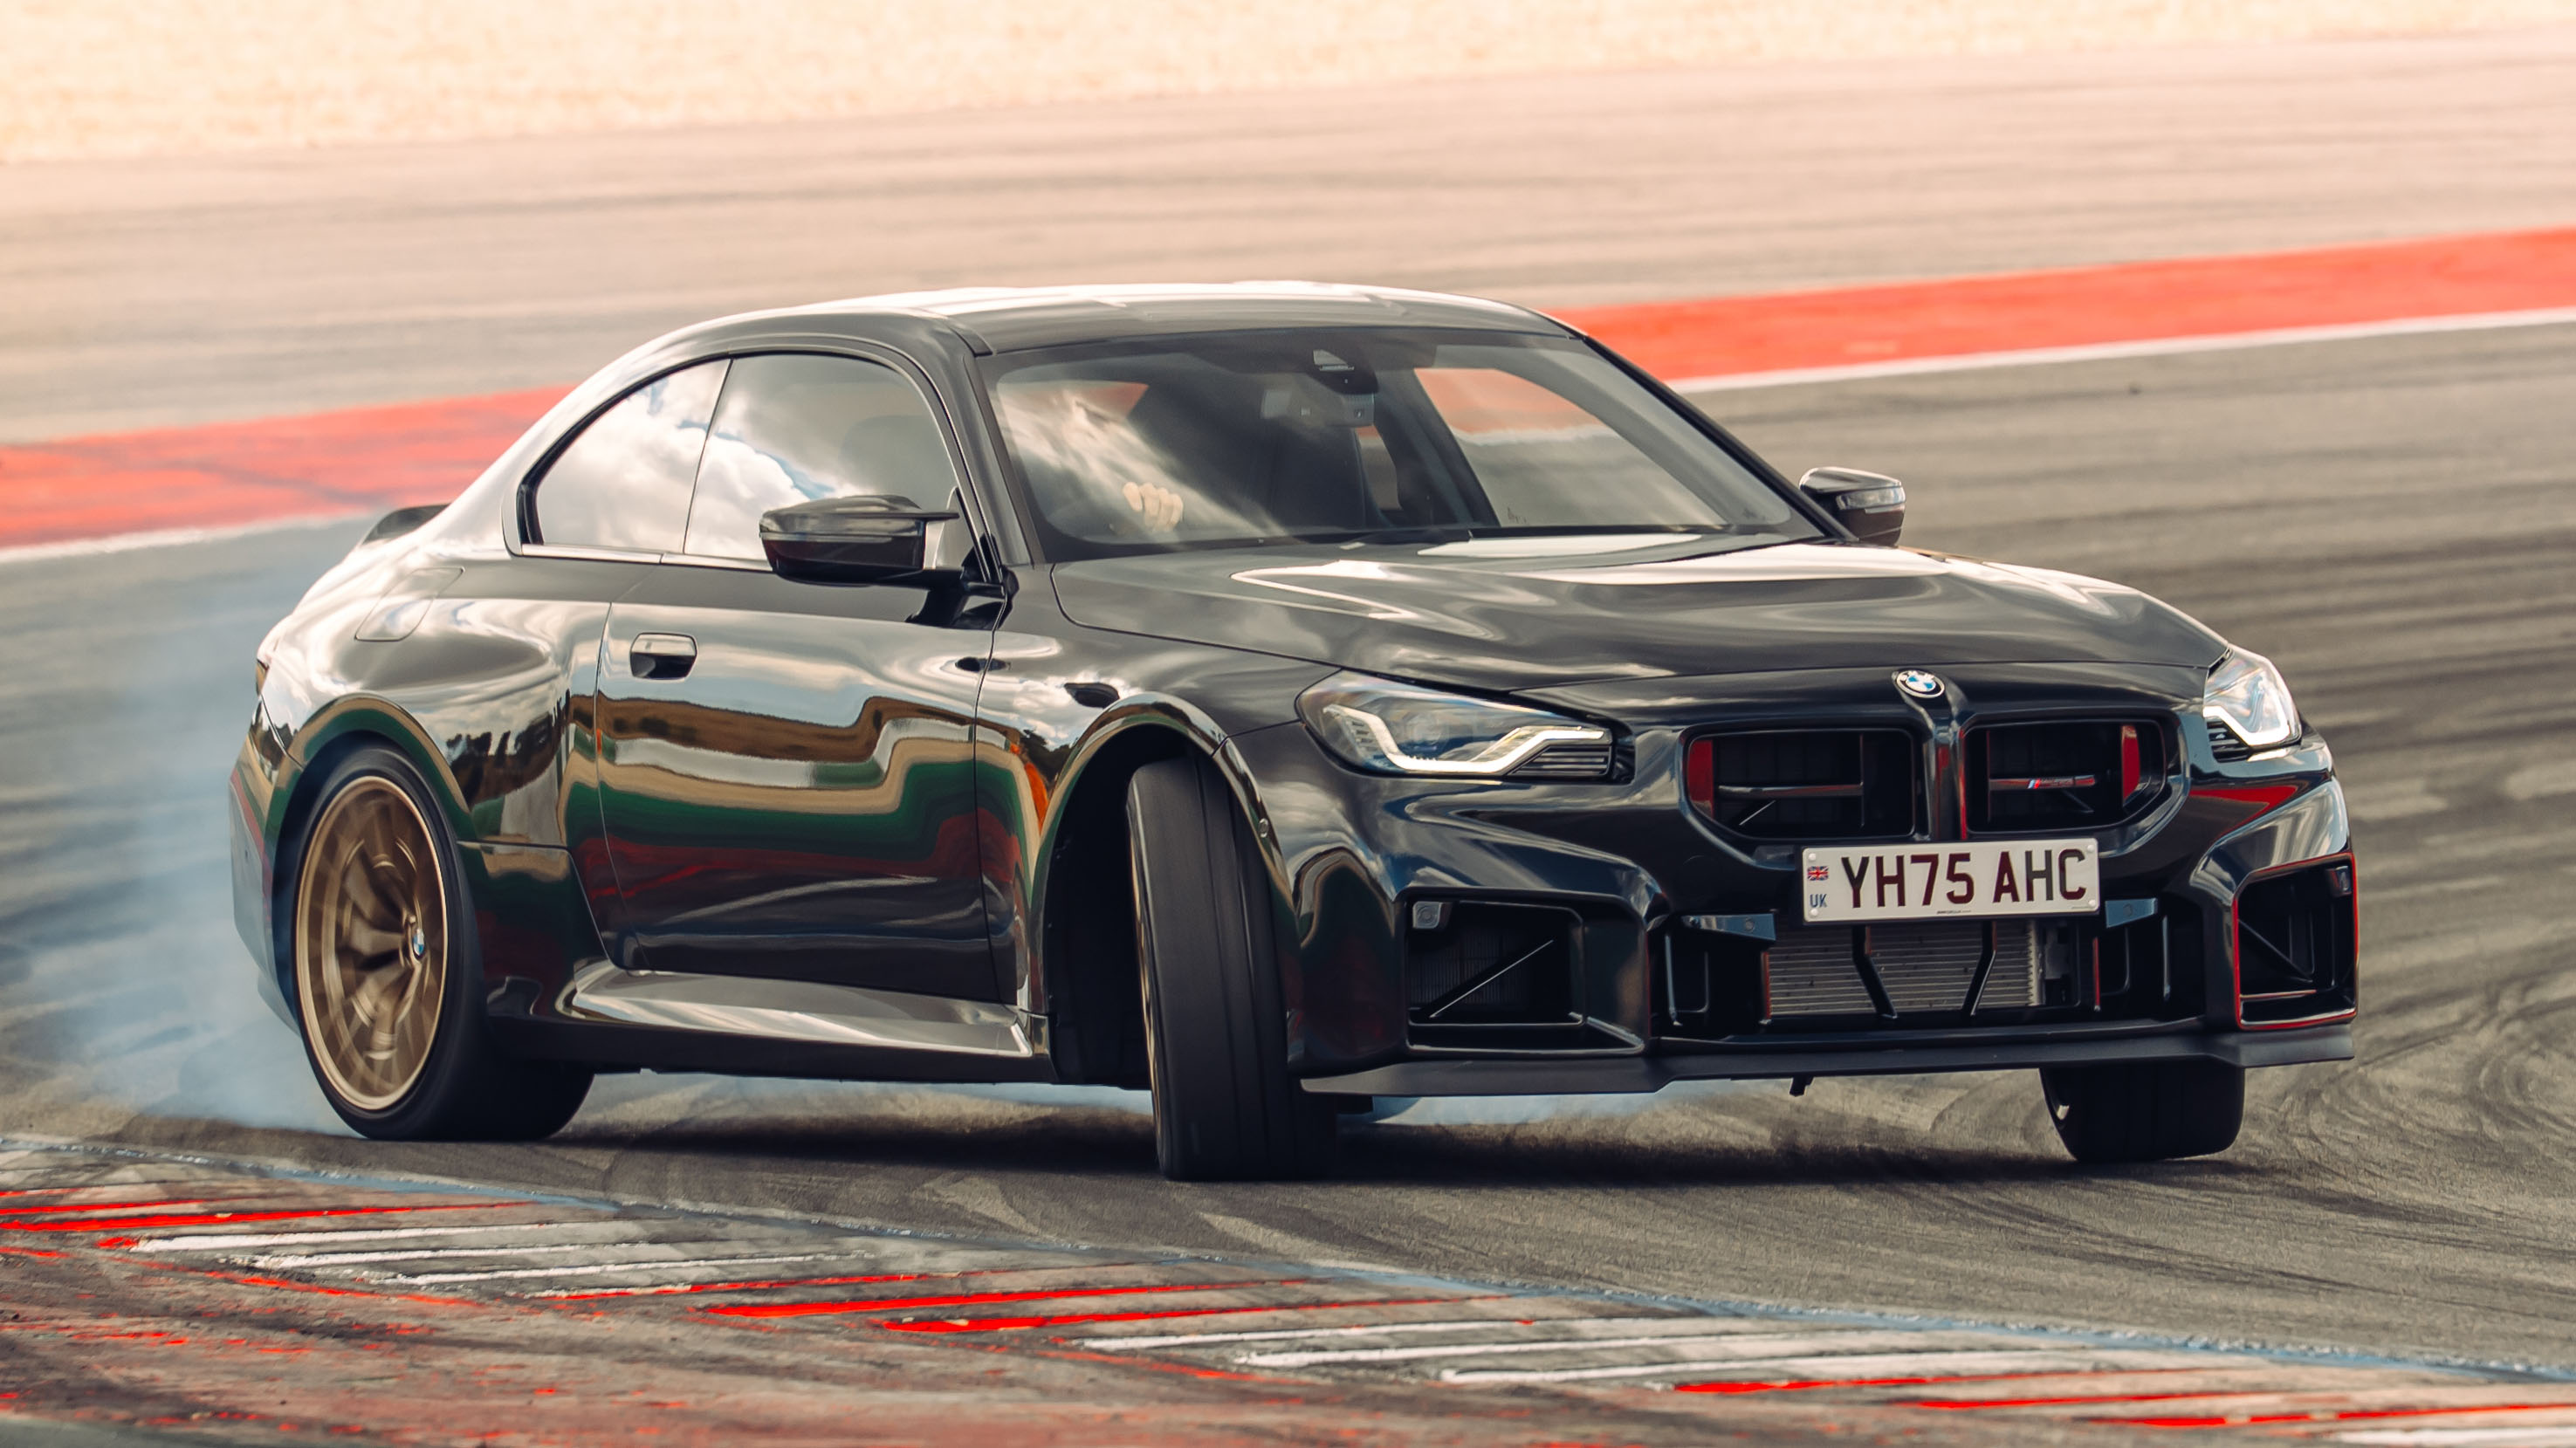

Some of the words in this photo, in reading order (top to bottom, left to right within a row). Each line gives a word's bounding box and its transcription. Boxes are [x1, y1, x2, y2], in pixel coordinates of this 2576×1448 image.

[1841, 852, 1975, 908] YH75
[1992, 848, 2087, 902] AHC
[1810, 893, 1828, 908] UK
